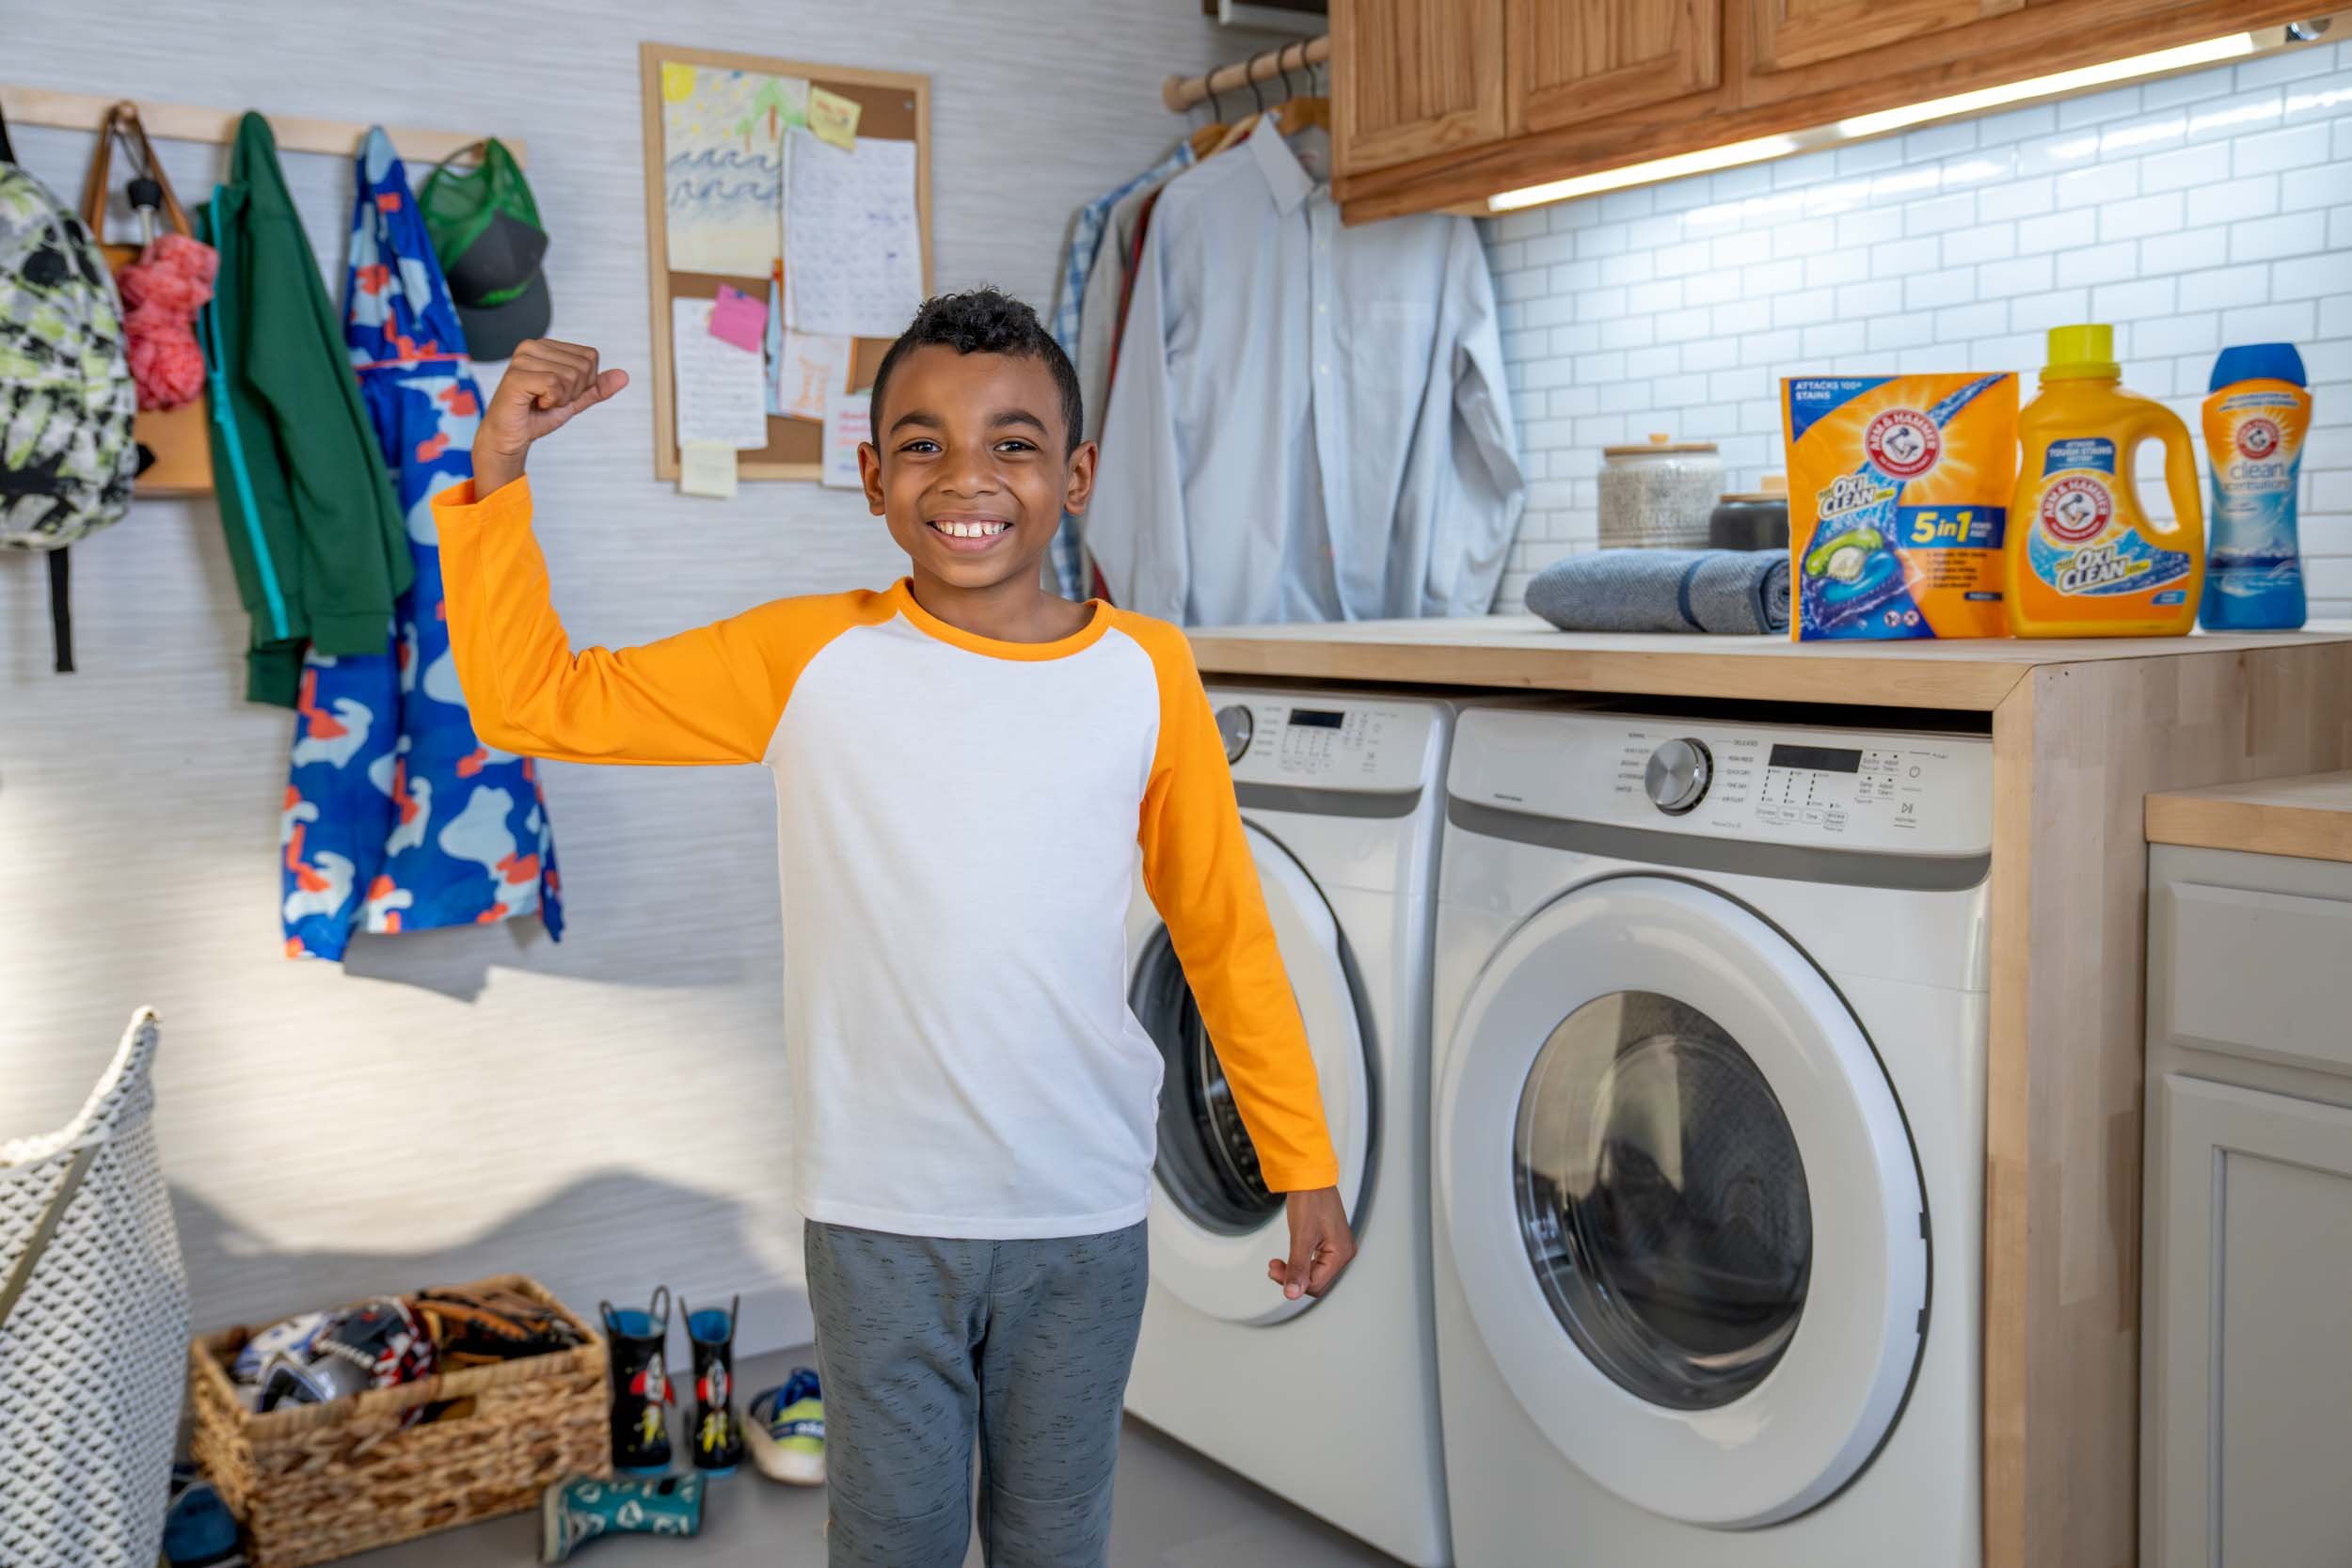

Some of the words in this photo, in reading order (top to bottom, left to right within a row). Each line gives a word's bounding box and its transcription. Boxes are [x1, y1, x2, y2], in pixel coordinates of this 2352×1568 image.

[1796, 390, 1831, 400] STAINS
[1893, 412, 1936, 450] HAMMER
[1821, 487, 1874, 516] CLEAN
[1835, 478, 1866, 498] OXI
[2069, 480, 2108, 515] HAMMER
[2075, 546, 2112, 568] OXI
[2061, 560, 2126, 591] CLEAN
